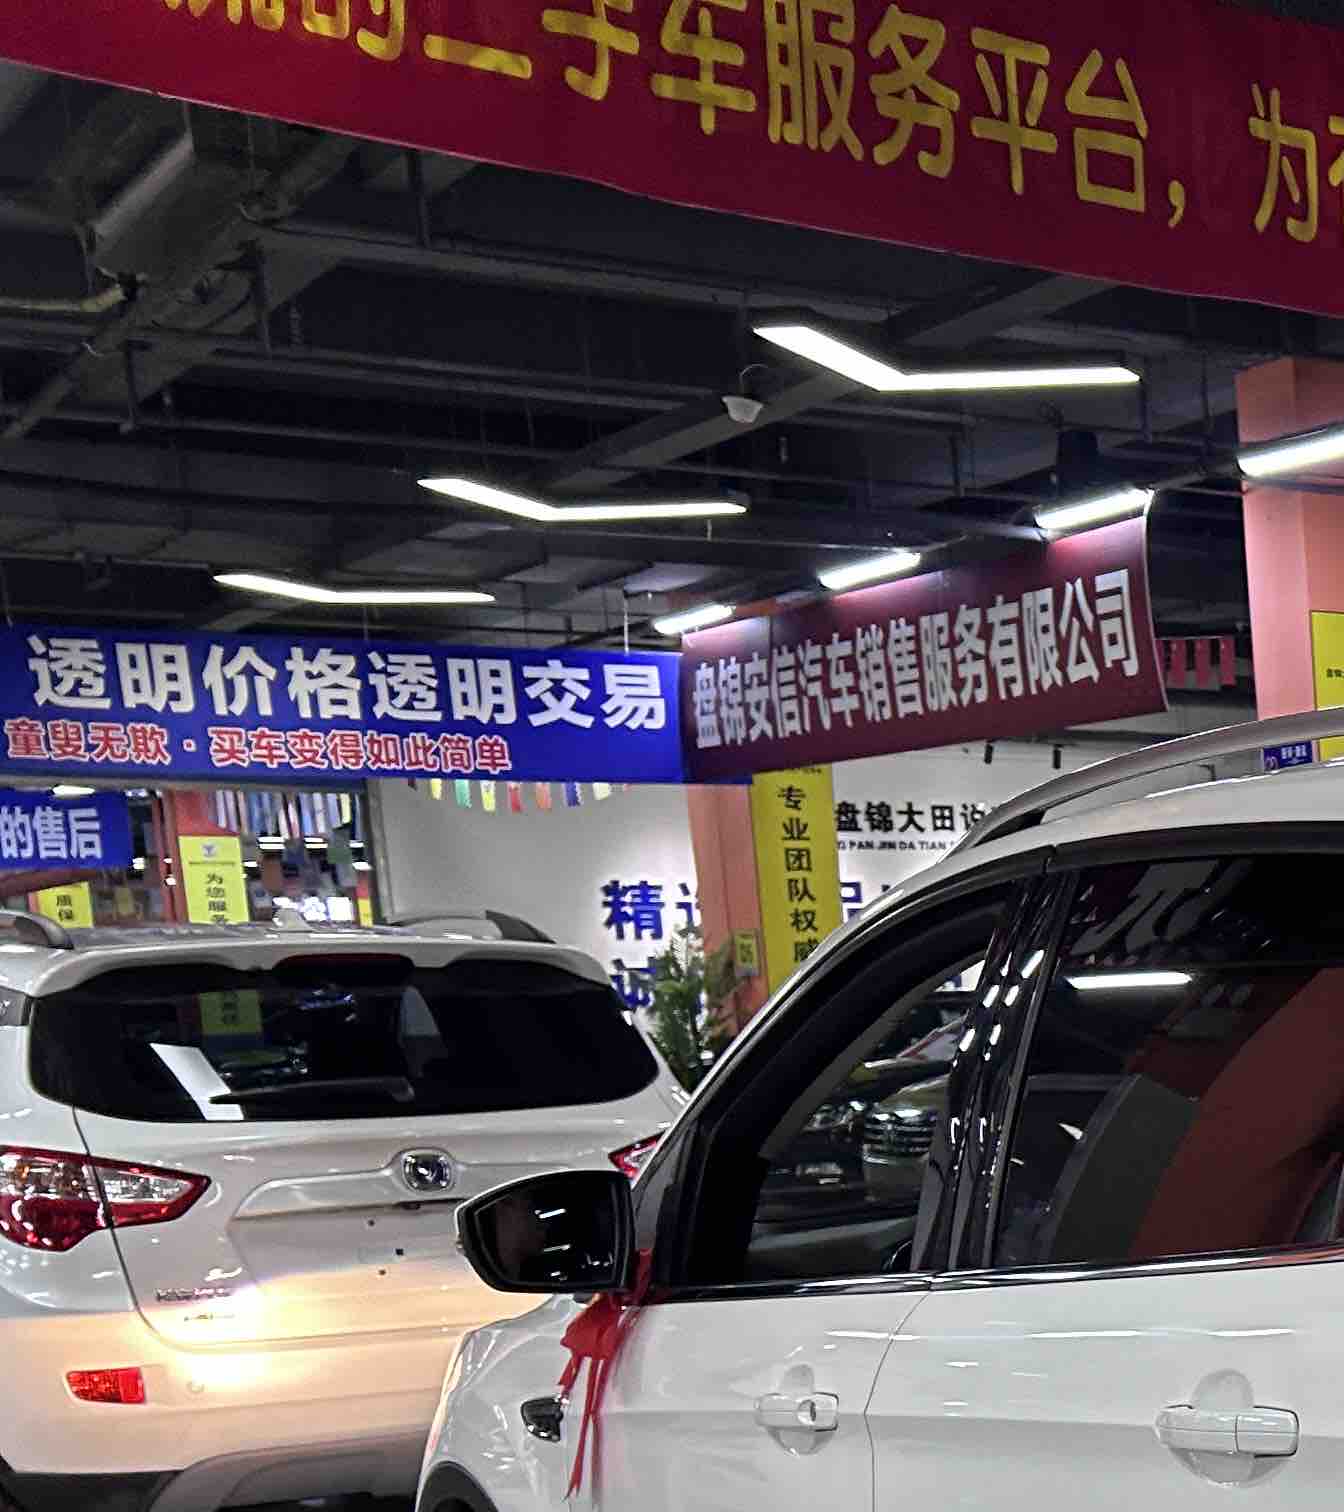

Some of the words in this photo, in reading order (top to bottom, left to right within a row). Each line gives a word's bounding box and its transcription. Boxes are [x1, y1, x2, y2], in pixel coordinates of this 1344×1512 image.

[27, 634, 666, 730] 透明价格透明交易
[692, 568, 1139, 750] 盘锦安信汽车销售服务有限公司
